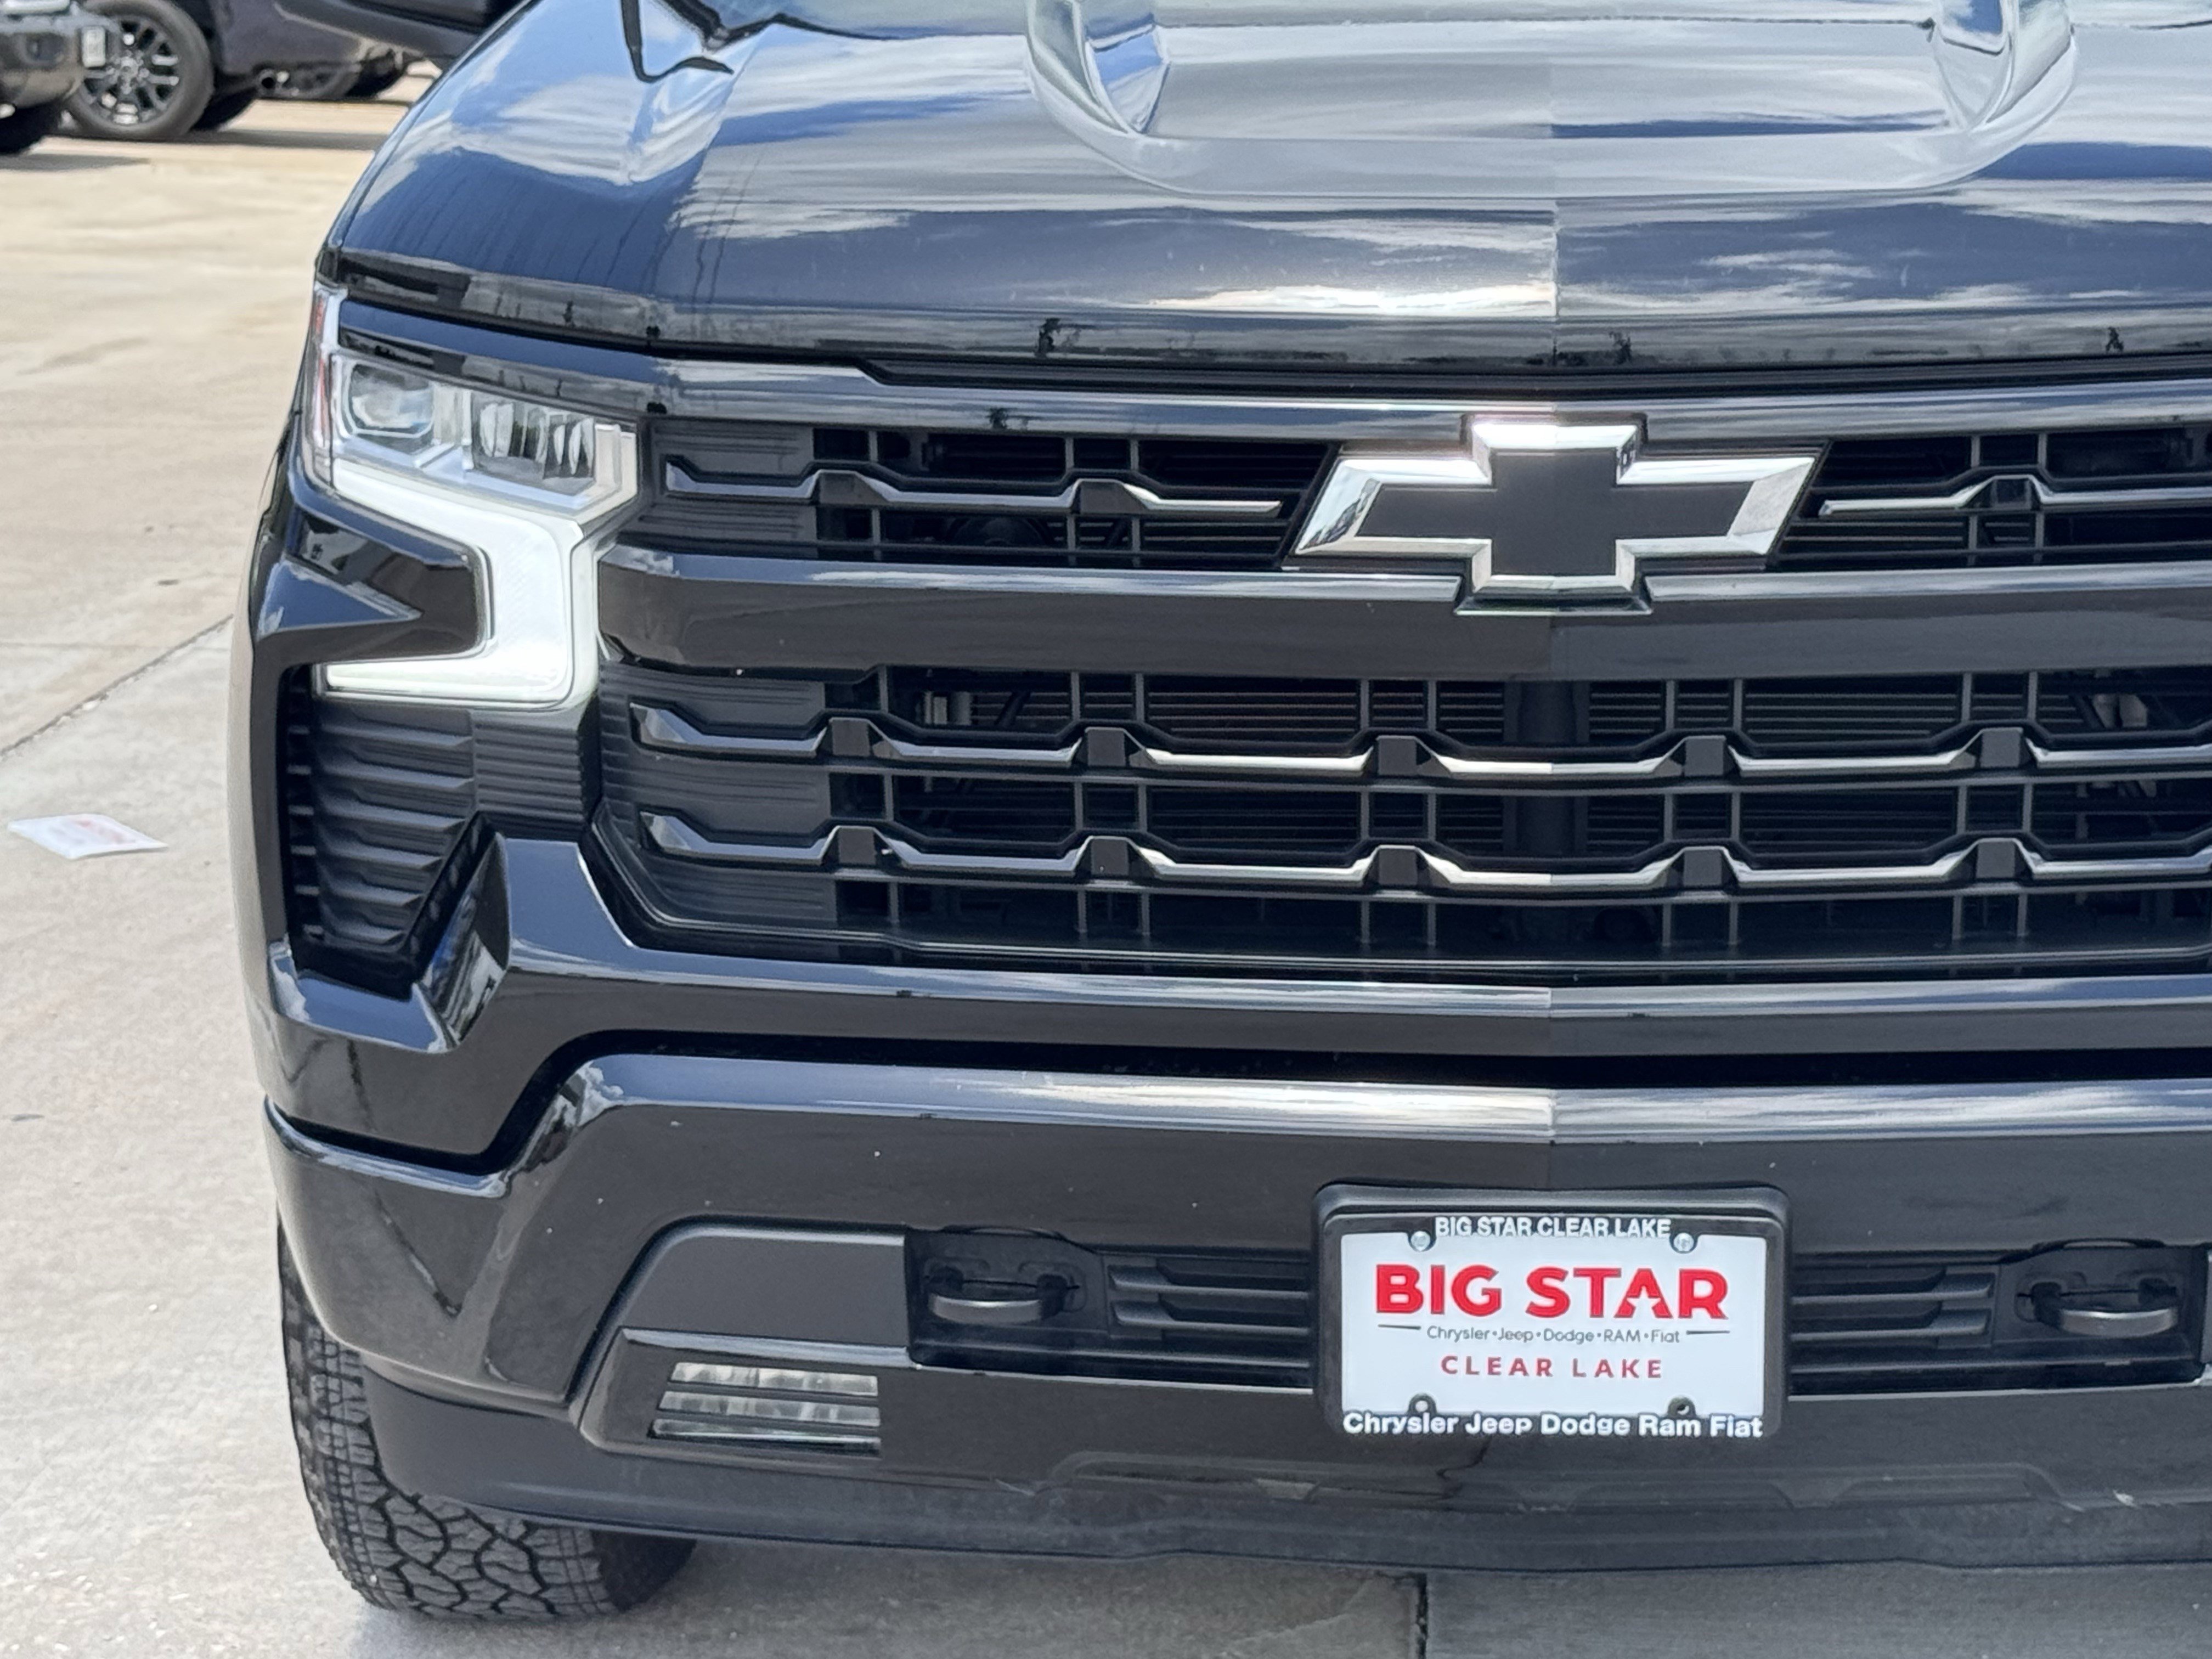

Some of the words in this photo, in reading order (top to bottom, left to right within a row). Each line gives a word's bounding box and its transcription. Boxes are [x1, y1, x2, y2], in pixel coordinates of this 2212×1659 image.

[1435, 1216, 1472, 1237] BIG
[1477, 1216, 1532, 1237] STAR
[1536, 1216, 1609, 1238] CLEAR
[1614, 1217, 1672, 1238] LAKE
[1376, 1264, 1502, 1317] BIG
[1526, 1266, 1729, 1319] STAR
[1441, 1356, 1553, 1377] CLEAR
[1572, 1358, 1662, 1379] LAKE
[1342, 1412, 1459, 1434] Chrysler
[1465, 1413, 1533, 1435] Jeep
[1540, 1412, 1631, 1436] Dodge
[1638, 1414, 1701, 1437] Ram
[1709, 1415, 1763, 1438] Fiat
